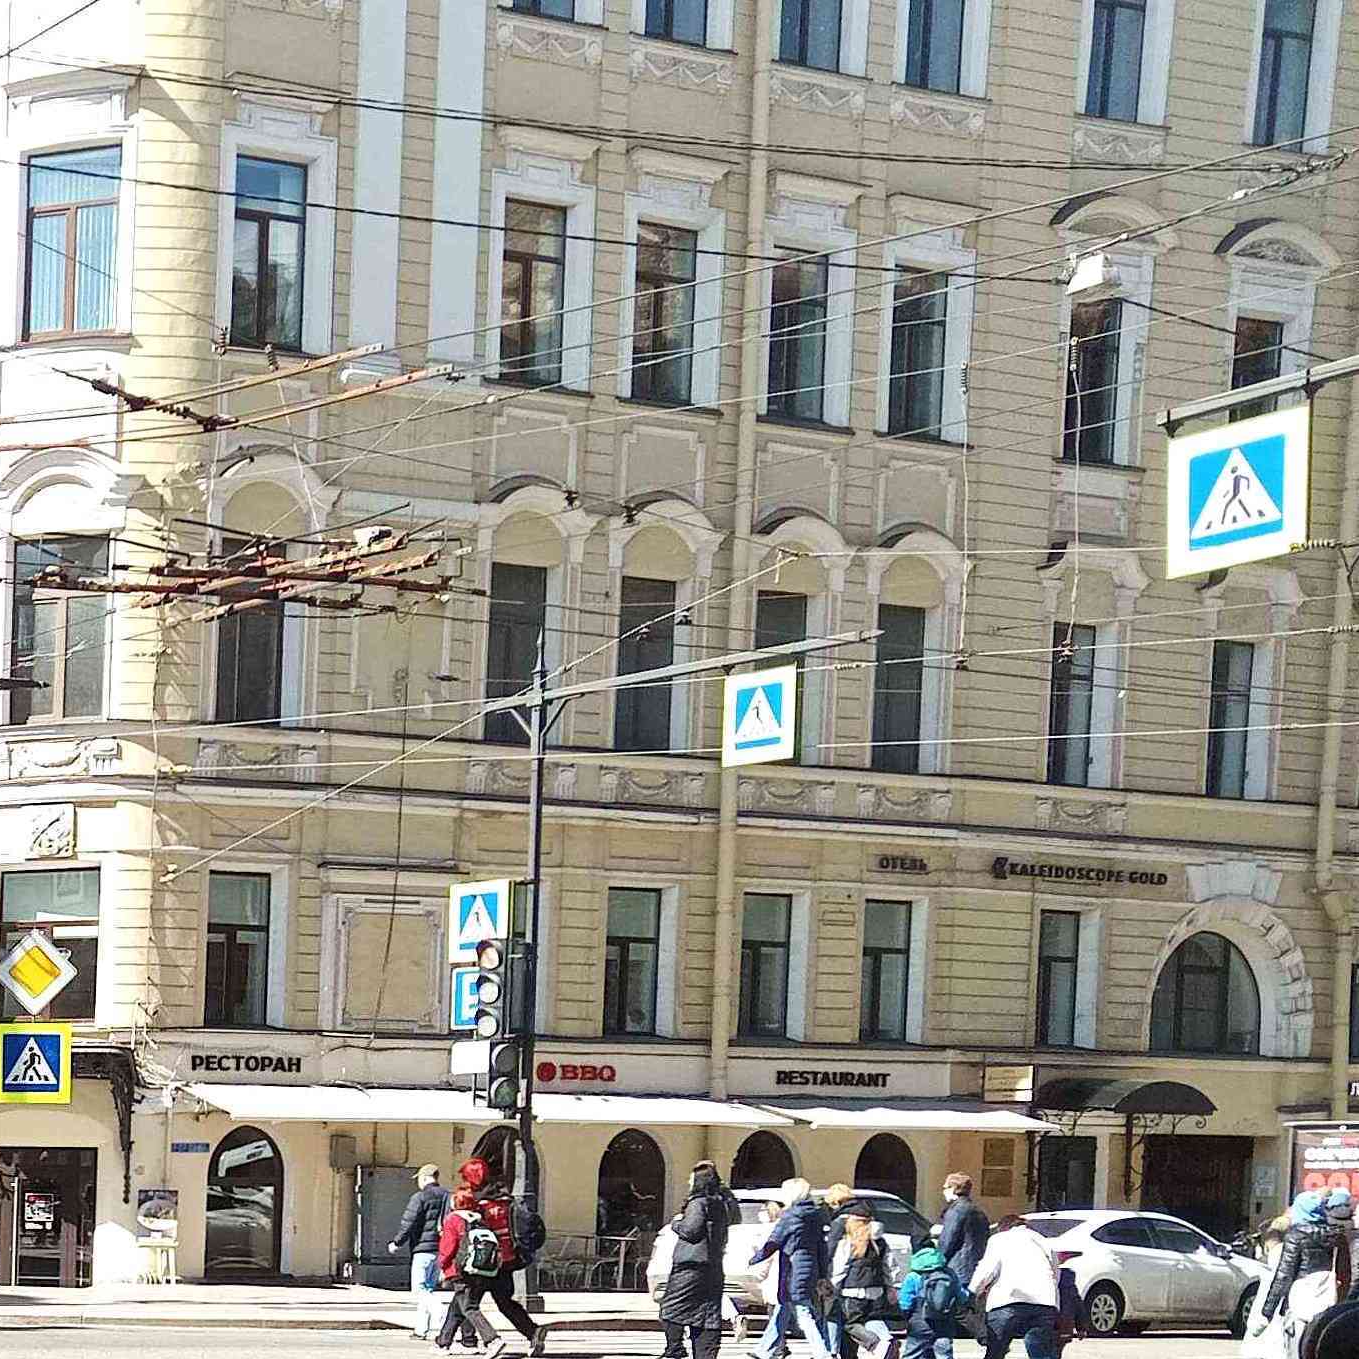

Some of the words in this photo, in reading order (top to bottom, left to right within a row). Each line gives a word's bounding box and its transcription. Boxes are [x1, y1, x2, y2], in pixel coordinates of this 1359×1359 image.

[1009, 862, 1124, 883] KALEIDOSCOPE
[1128, 871, 1168, 886] GOLD
[191, 1055, 302, 1073] РЕСТОРАН
[559, 1064, 617, 1082] BBQ
[776, 1070, 891, 1088] RESTAURANT
